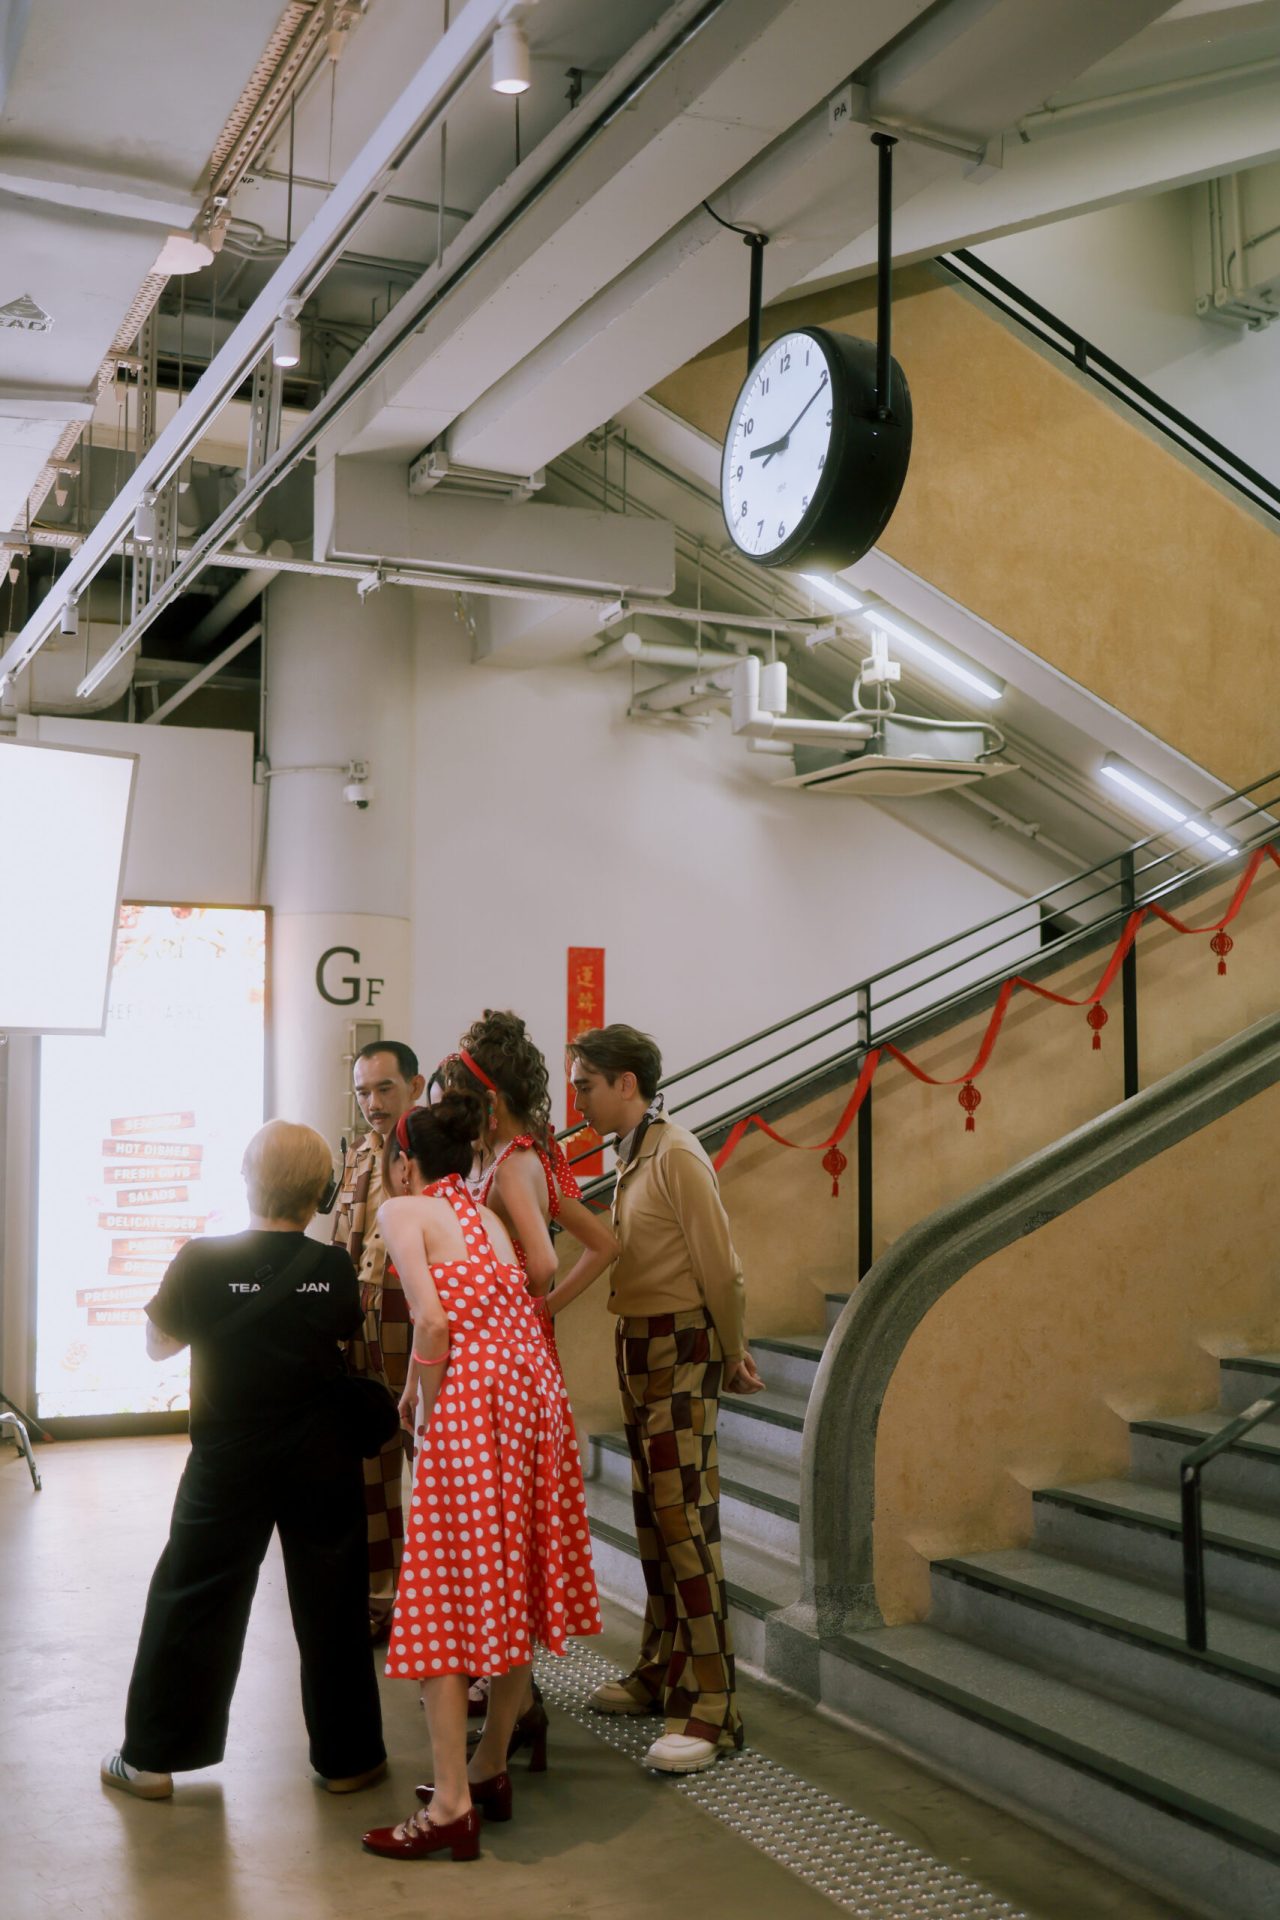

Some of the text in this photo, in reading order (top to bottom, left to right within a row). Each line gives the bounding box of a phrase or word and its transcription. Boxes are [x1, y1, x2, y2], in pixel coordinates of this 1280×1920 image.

[833, 102, 847, 121] PA
[780, 353, 791, 374] 12
[761, 378, 769, 396] 11
[743, 418, 754, 438] 10
[736, 465, 743, 481] 9
[741, 500, 748, 517] 8
[757, 519, 764, 538] 7
[777, 520, 785, 538] 6
[315, 945, 385, 1006] GF
[115, 1142, 142, 1154] HOT
[114, 1167, 156, 1180] FRESH
[127, 1188, 177, 1203] SALADS
